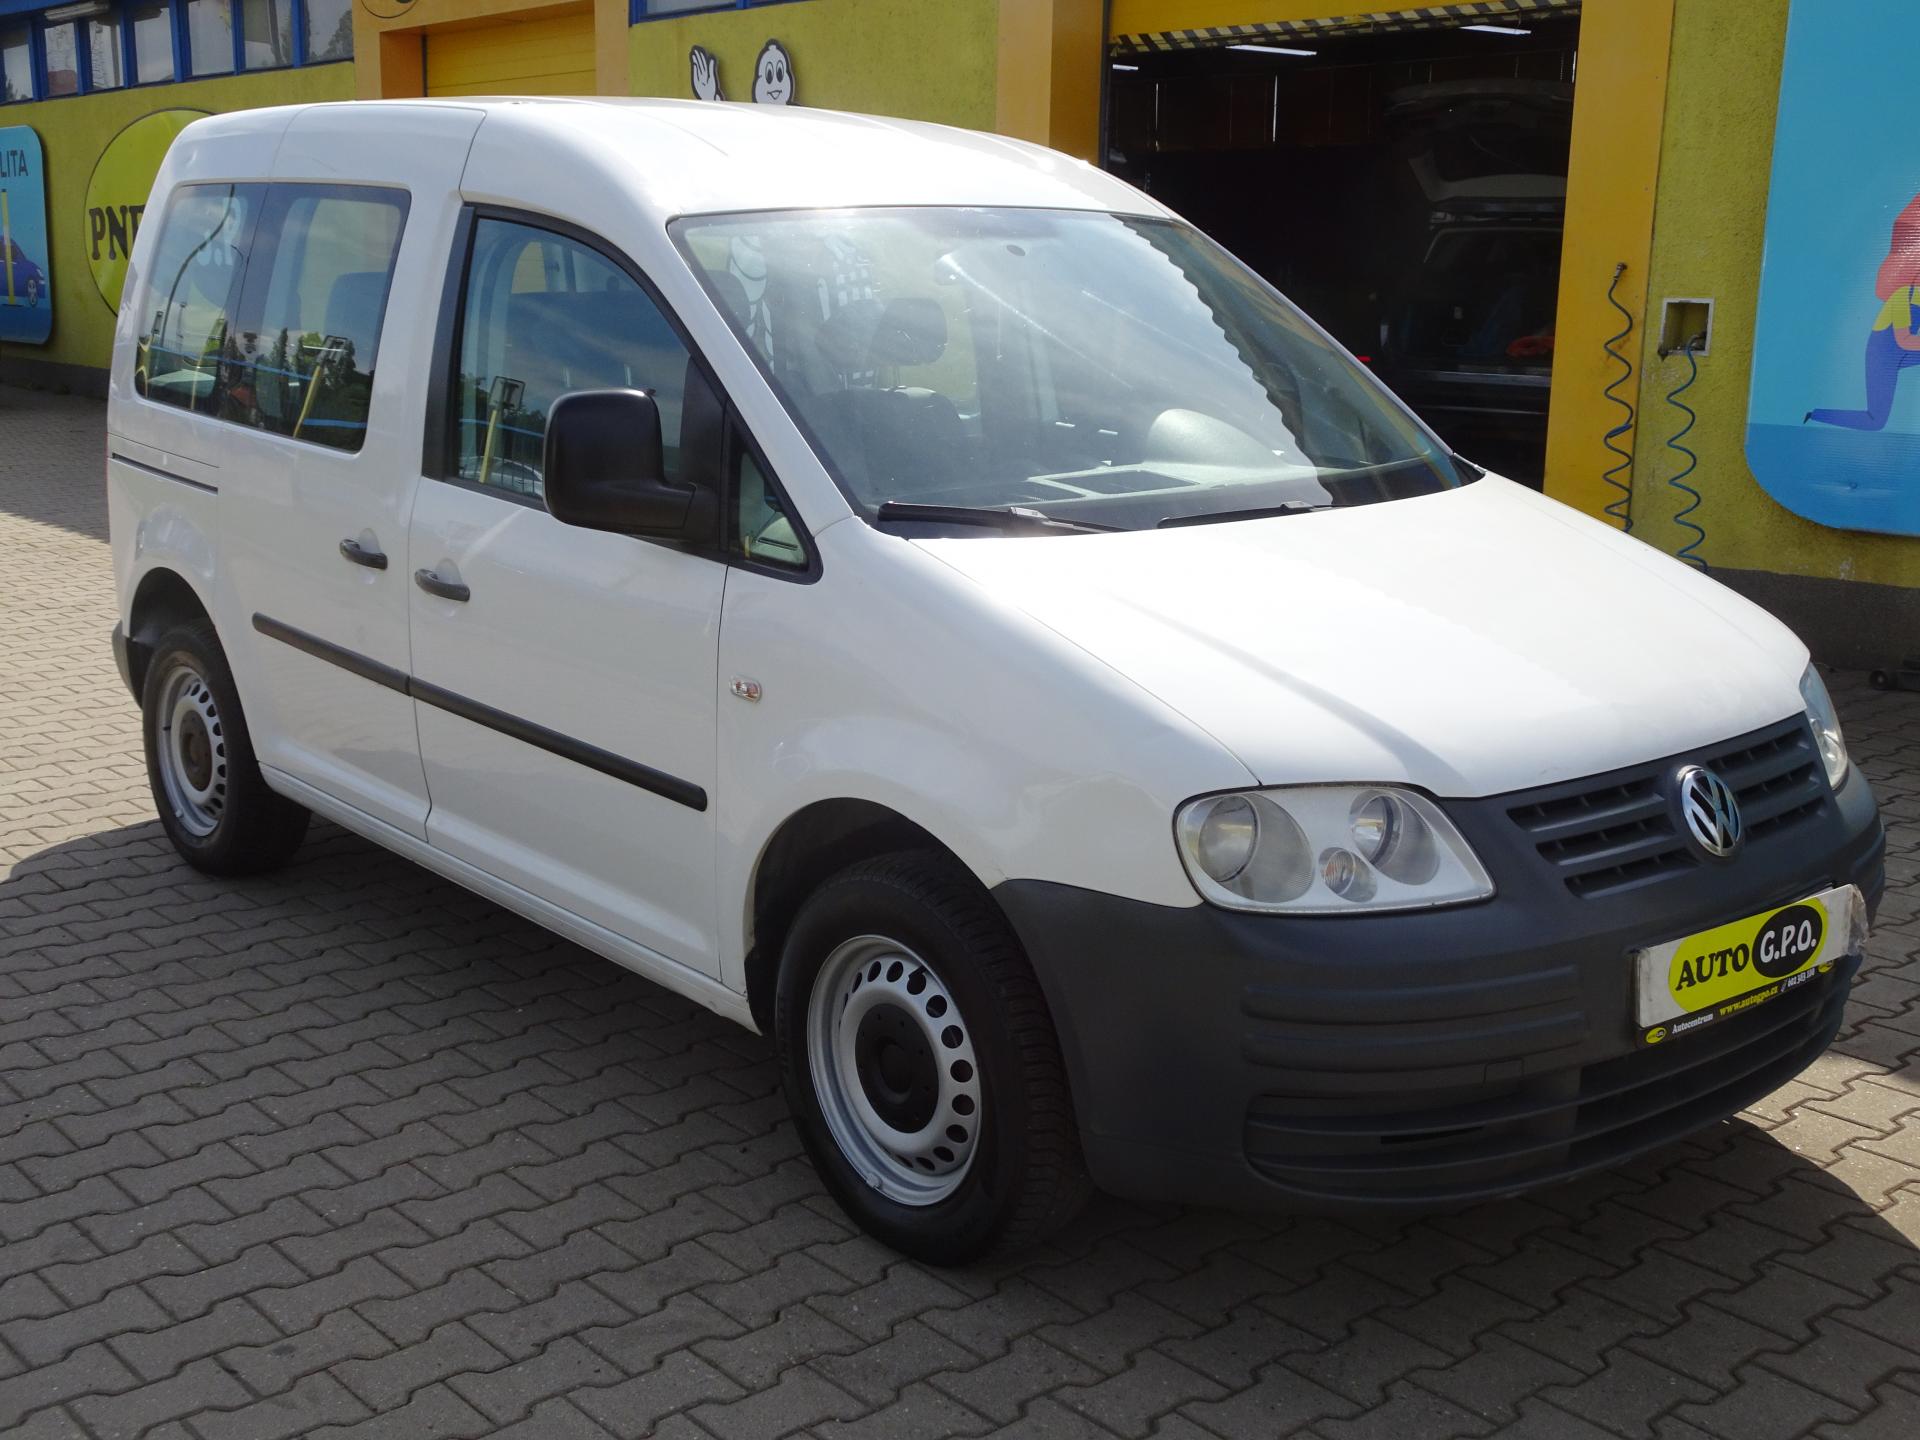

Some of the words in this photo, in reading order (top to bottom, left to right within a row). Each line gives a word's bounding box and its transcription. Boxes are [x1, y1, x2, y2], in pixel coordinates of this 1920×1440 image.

[0, 149, 29, 178] LITA
[1674, 942, 1750, 991] AUTO
[1759, 919, 1817, 963] G.P.O.
[1671, 1013, 1714, 1035] Autocentrum
